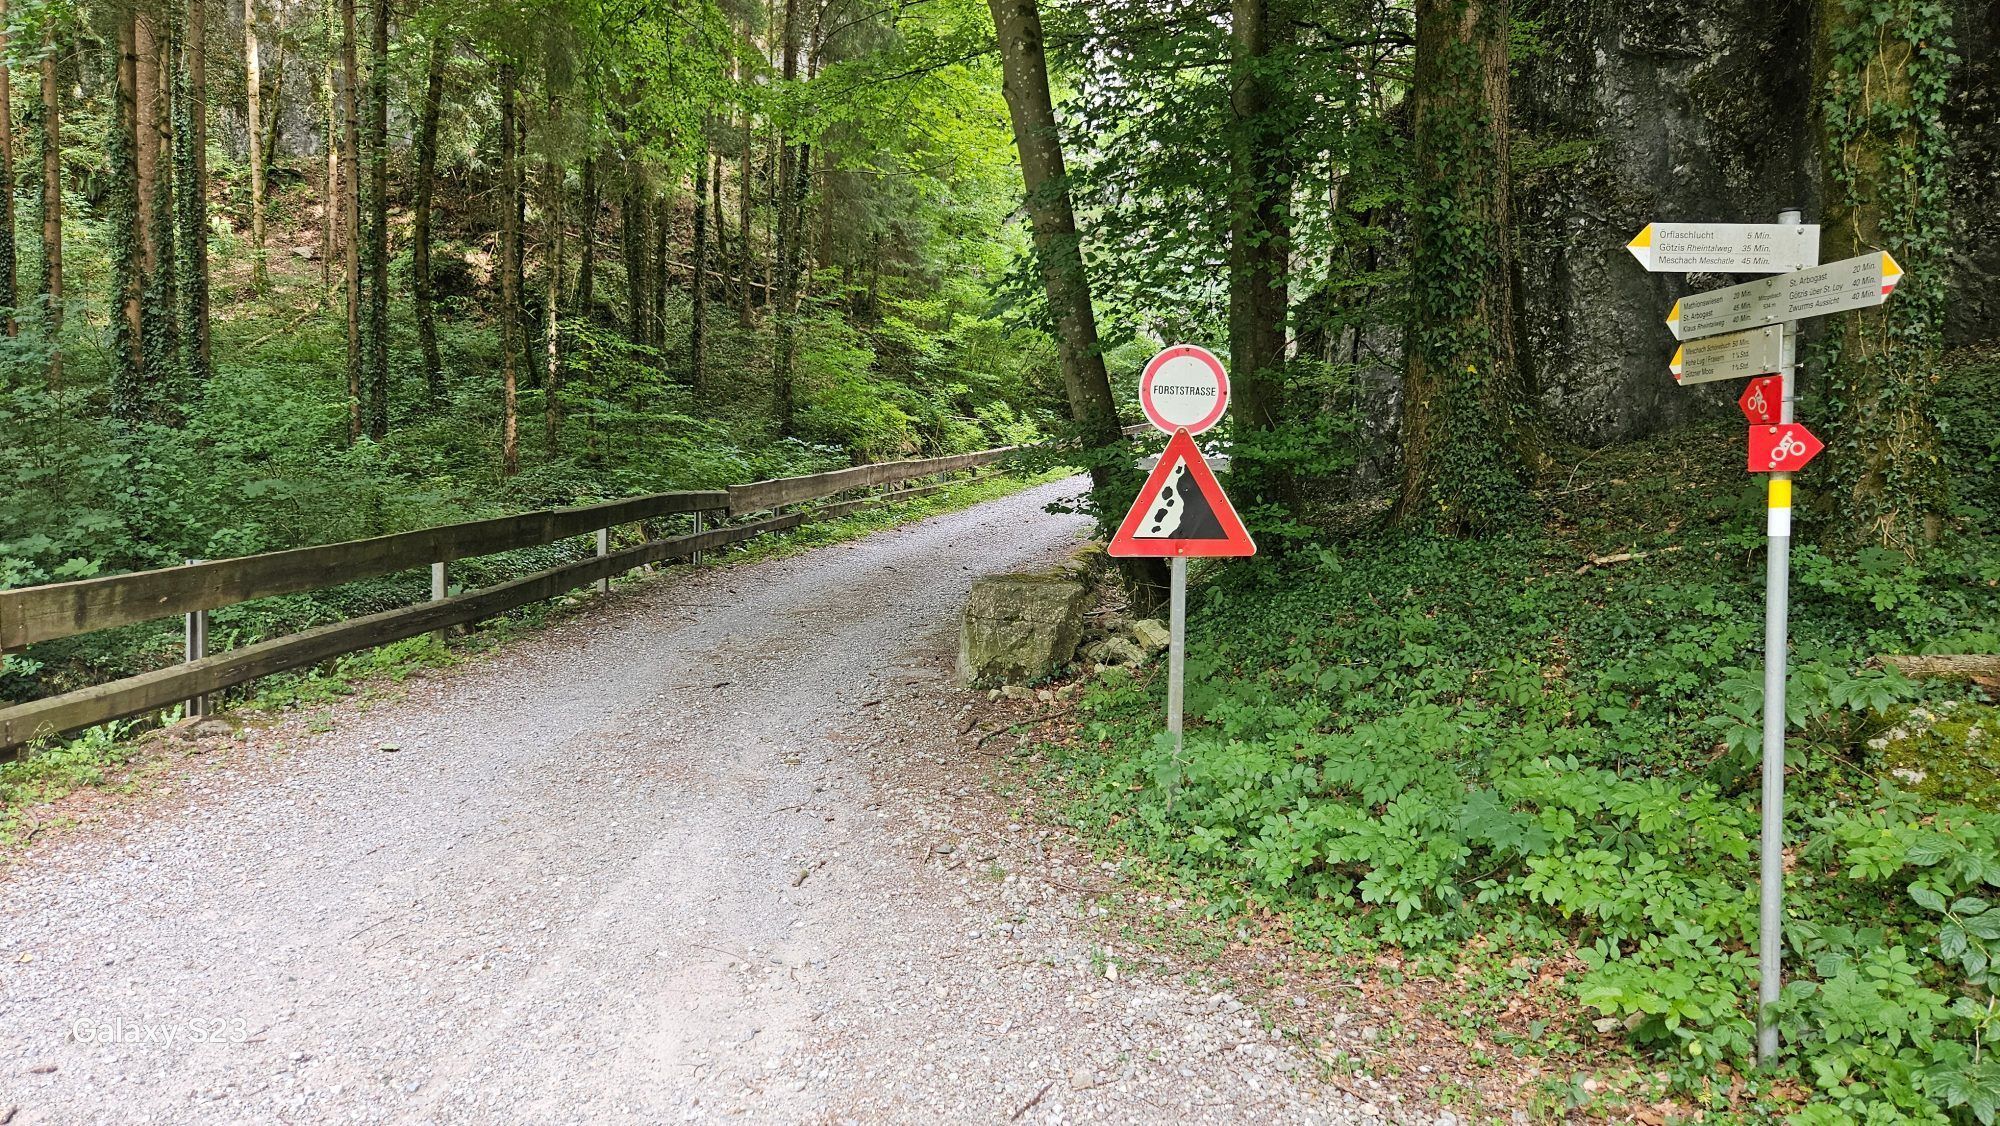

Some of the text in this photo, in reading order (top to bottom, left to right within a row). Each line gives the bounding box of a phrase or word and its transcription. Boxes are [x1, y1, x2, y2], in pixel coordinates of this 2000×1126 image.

[1754, 231, 1771, 239] Min.
[1659, 243, 1771, 254] Götzis Rheintalweg 35 Min.
[1658, 256, 1697, 264] Meschach
[1741, 257, 1751, 265] 45
[1752, 257, 1770, 265] Min.
[1789, 262, 1876, 287] St. Arbogast 20 Min.
[1740, 289, 1752, 298] Min.
[1789, 290, 1808, 300] Götzis
[1809, 287, 1823, 296] über
[1832, 283, 1844, 292] Loy
[1852, 279, 1861, 287] 40
[1861, 276, 1876, 285] Min.
[1788, 290, 1876, 312] Zwurms Aussicht 40 Min.
[1691, 309, 1714, 320] Arbogast
[1740, 302, 1752, 310] Min.
[1740, 314, 1752, 322] Min.
[1153, 385, 1217, 397] FORSTSTRASSE
